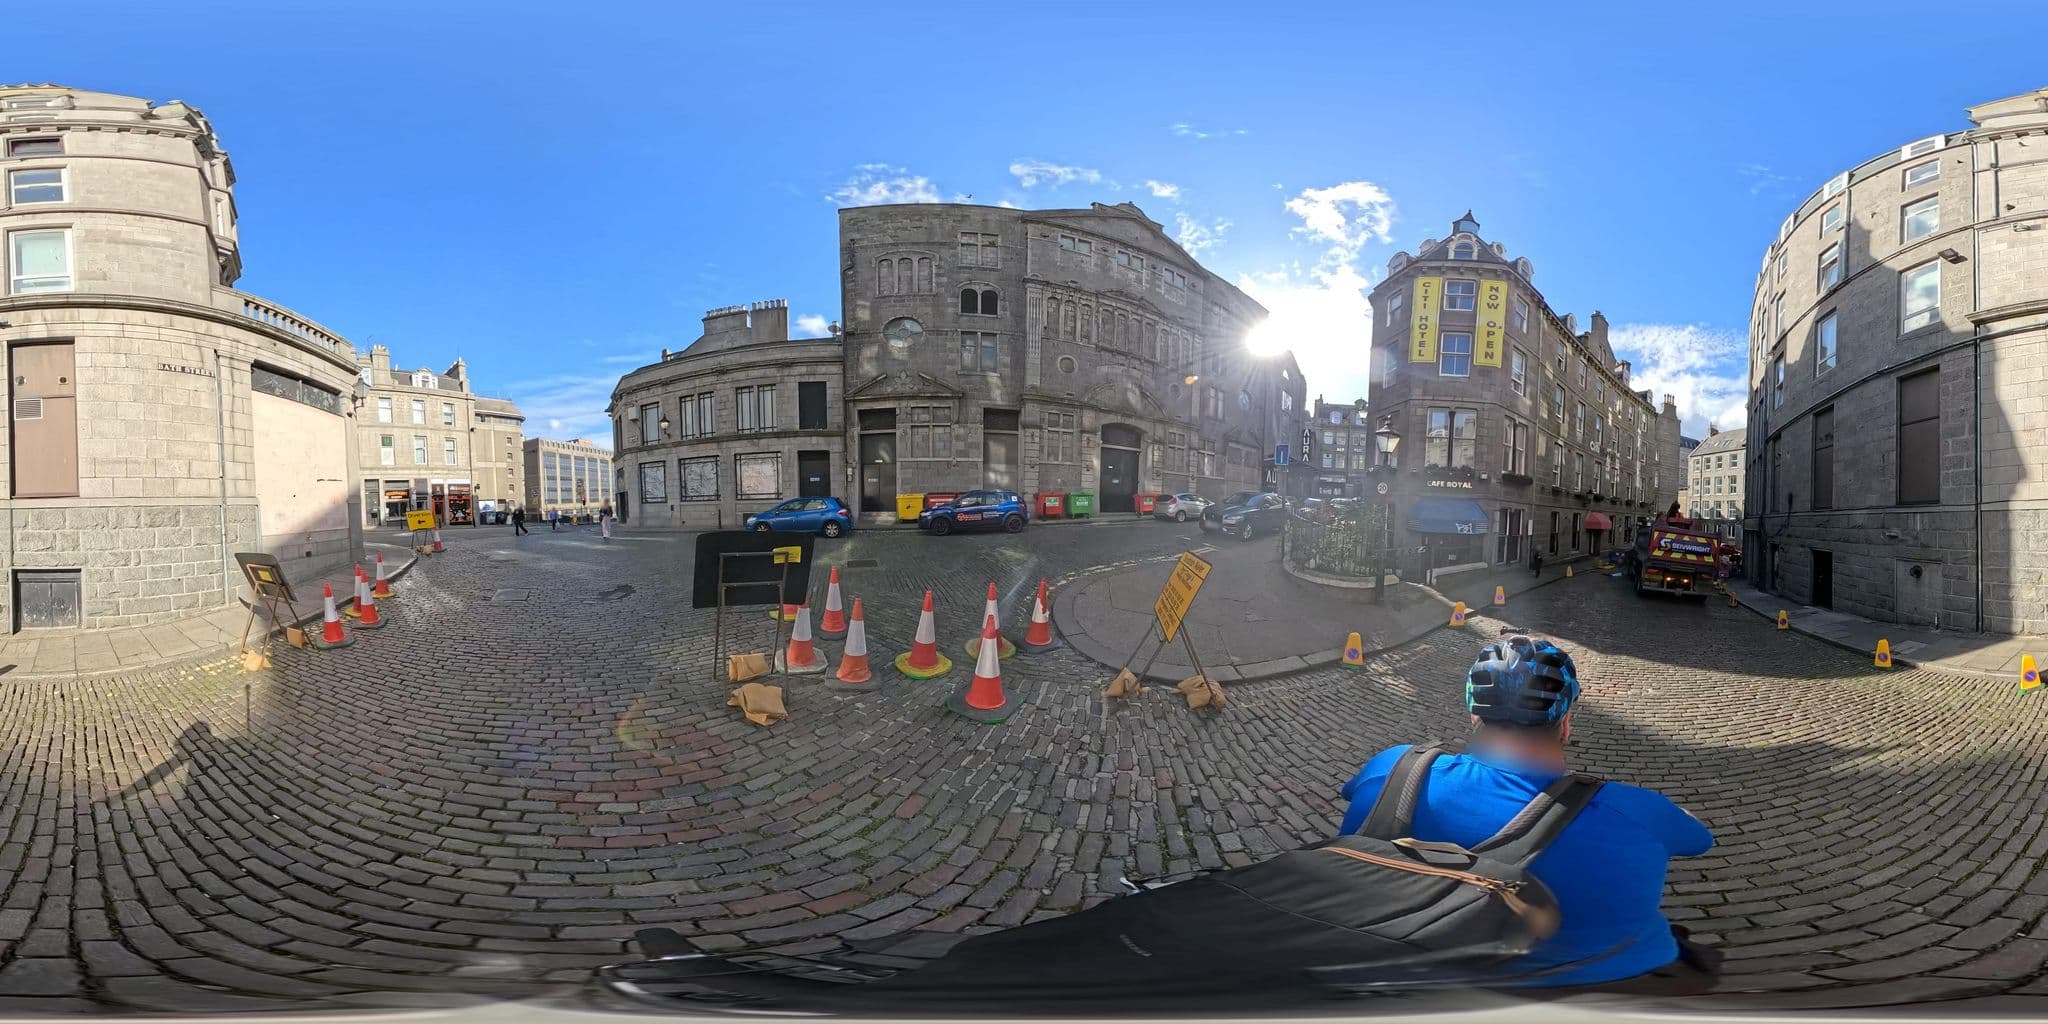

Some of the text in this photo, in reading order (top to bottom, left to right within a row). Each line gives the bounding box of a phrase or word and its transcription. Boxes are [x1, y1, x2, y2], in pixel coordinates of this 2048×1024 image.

[1418, 281, 1432, 357] CITI HOTEL
[1484, 285, 1500, 360] NOW OPEN
[1302, 428, 1310, 462] AURA
[1427, 479, 1473, 489] CAFE ROYAL
